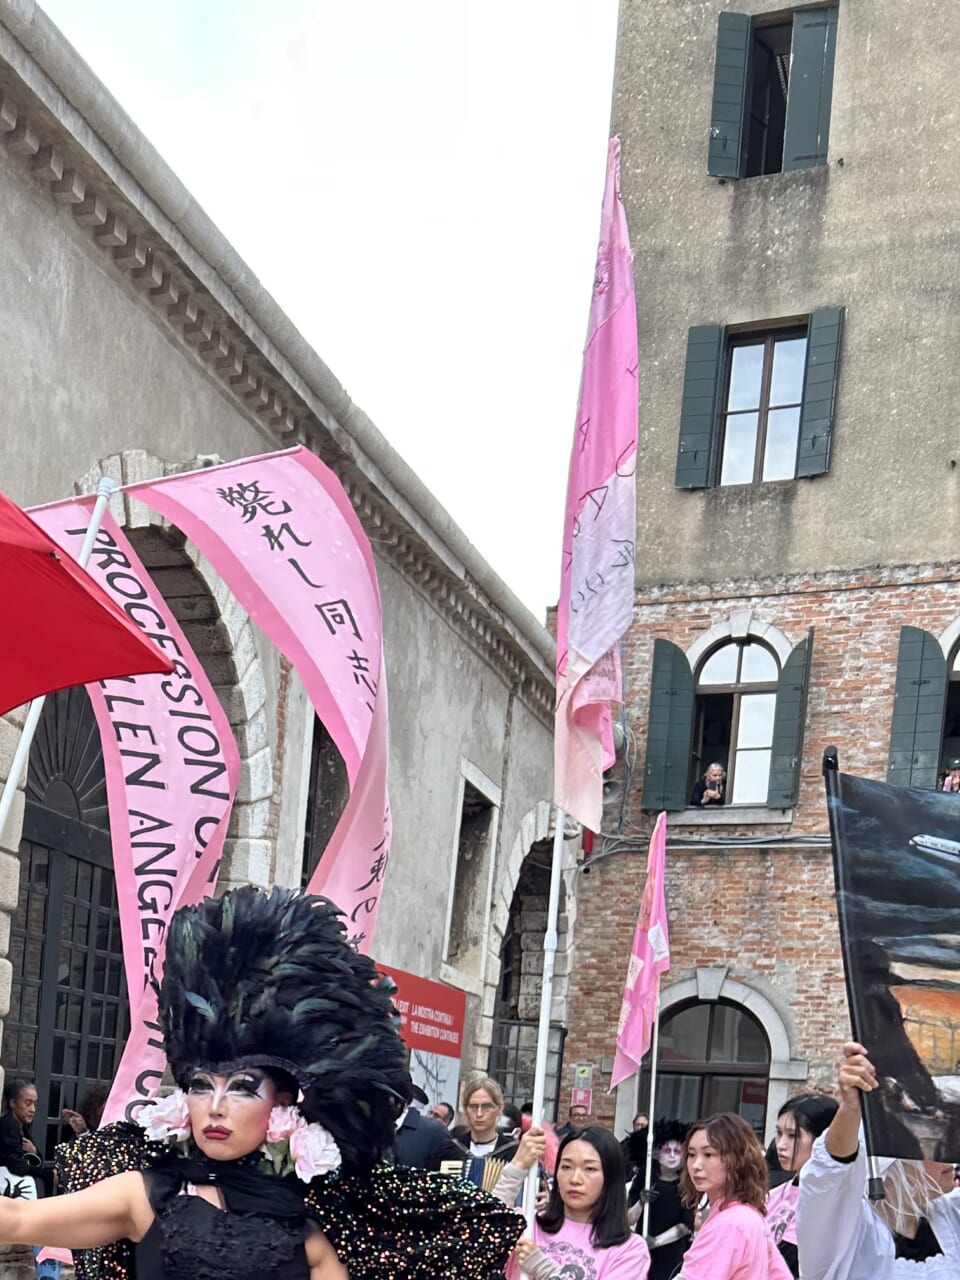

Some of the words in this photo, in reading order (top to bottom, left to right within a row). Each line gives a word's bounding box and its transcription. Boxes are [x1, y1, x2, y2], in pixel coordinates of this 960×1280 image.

[216, 480, 377, 713] 斃れし同志
[410, 1020, 419, 1034] THE
